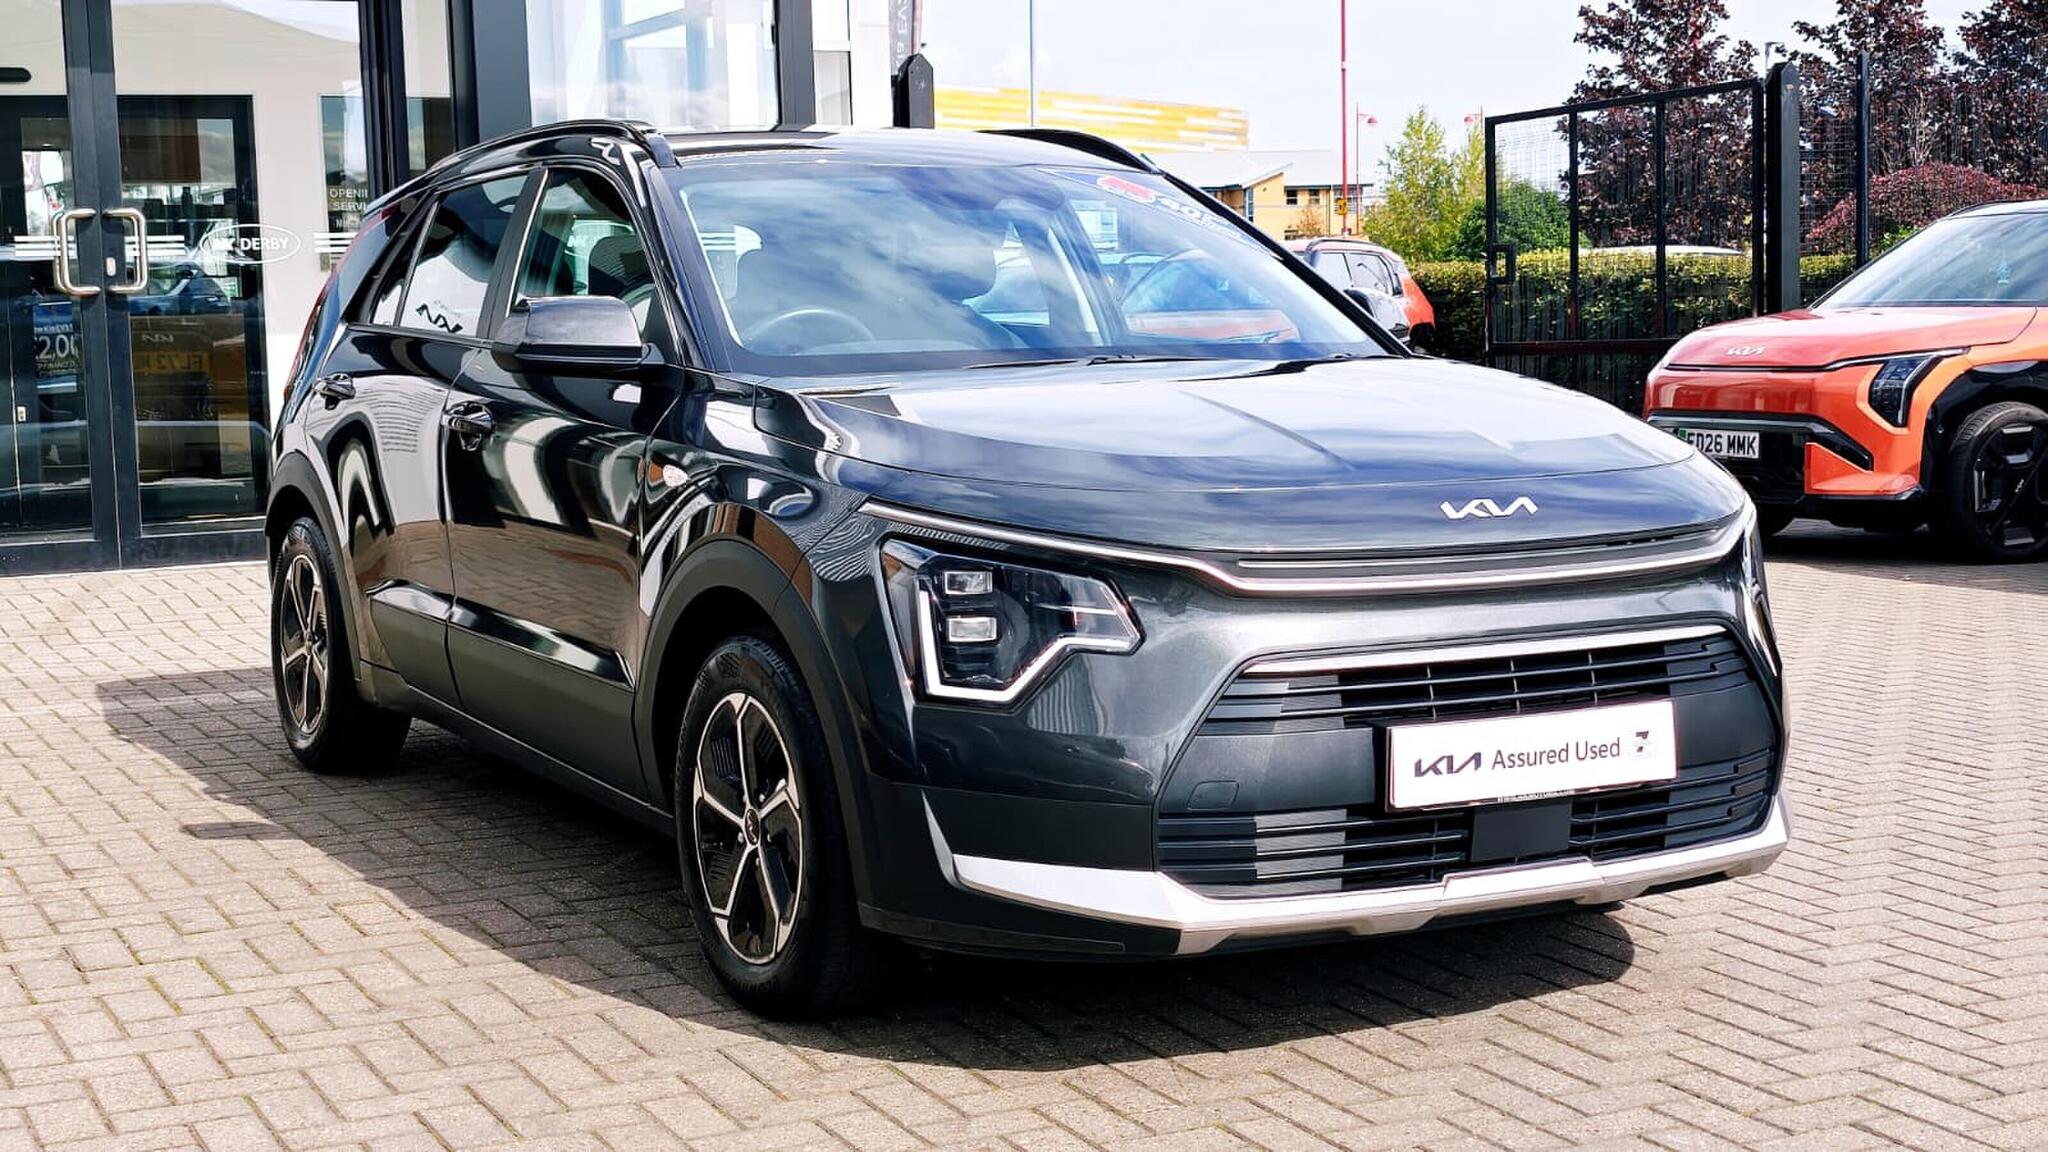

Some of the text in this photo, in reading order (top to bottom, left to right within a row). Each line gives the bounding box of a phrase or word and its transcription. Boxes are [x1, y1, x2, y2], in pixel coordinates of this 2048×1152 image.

[240, 237, 288, 251] DERBY
[1727, 434, 1756, 456] MMK
[1440, 496, 1539, 519] KIA
[1414, 752, 1482, 777] KIA
[1492, 742, 1569, 770] Assured
[1575, 737, 1620, 761] Used
